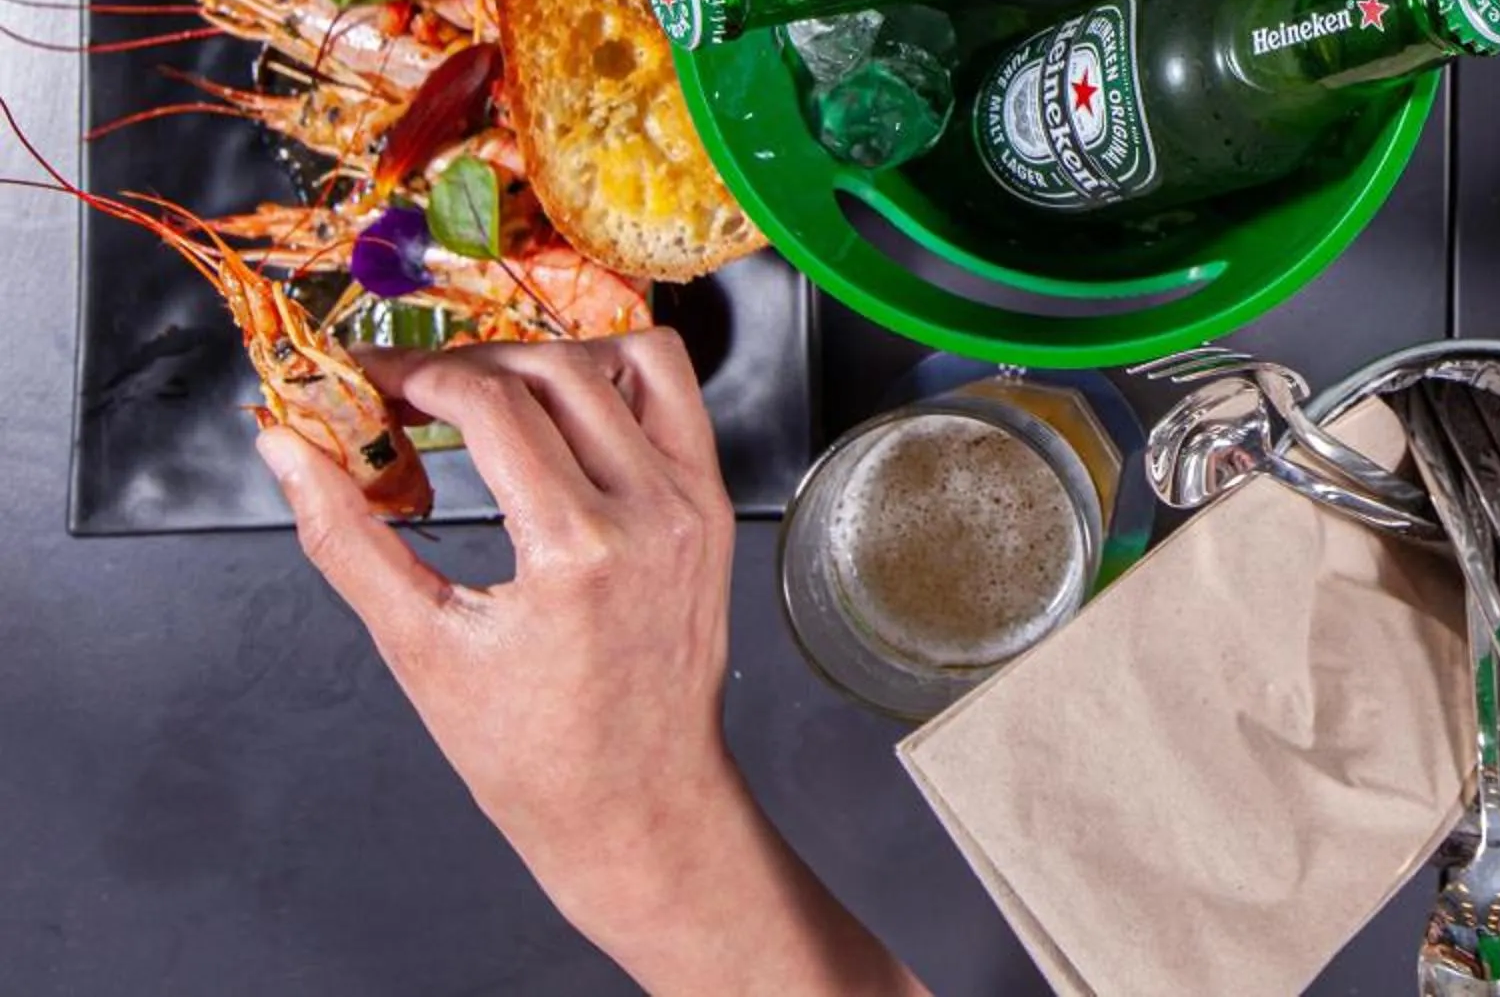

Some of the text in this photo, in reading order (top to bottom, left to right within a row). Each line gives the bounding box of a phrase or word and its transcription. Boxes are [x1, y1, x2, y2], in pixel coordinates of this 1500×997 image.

[1252, 8, 1354, 56] Heineken
[987, 45, 1049, 188] PURE MALT LAGER
[1043, 15, 1108, 193] Heineken
[1101, 89, 1129, 170] ORIGINAL
